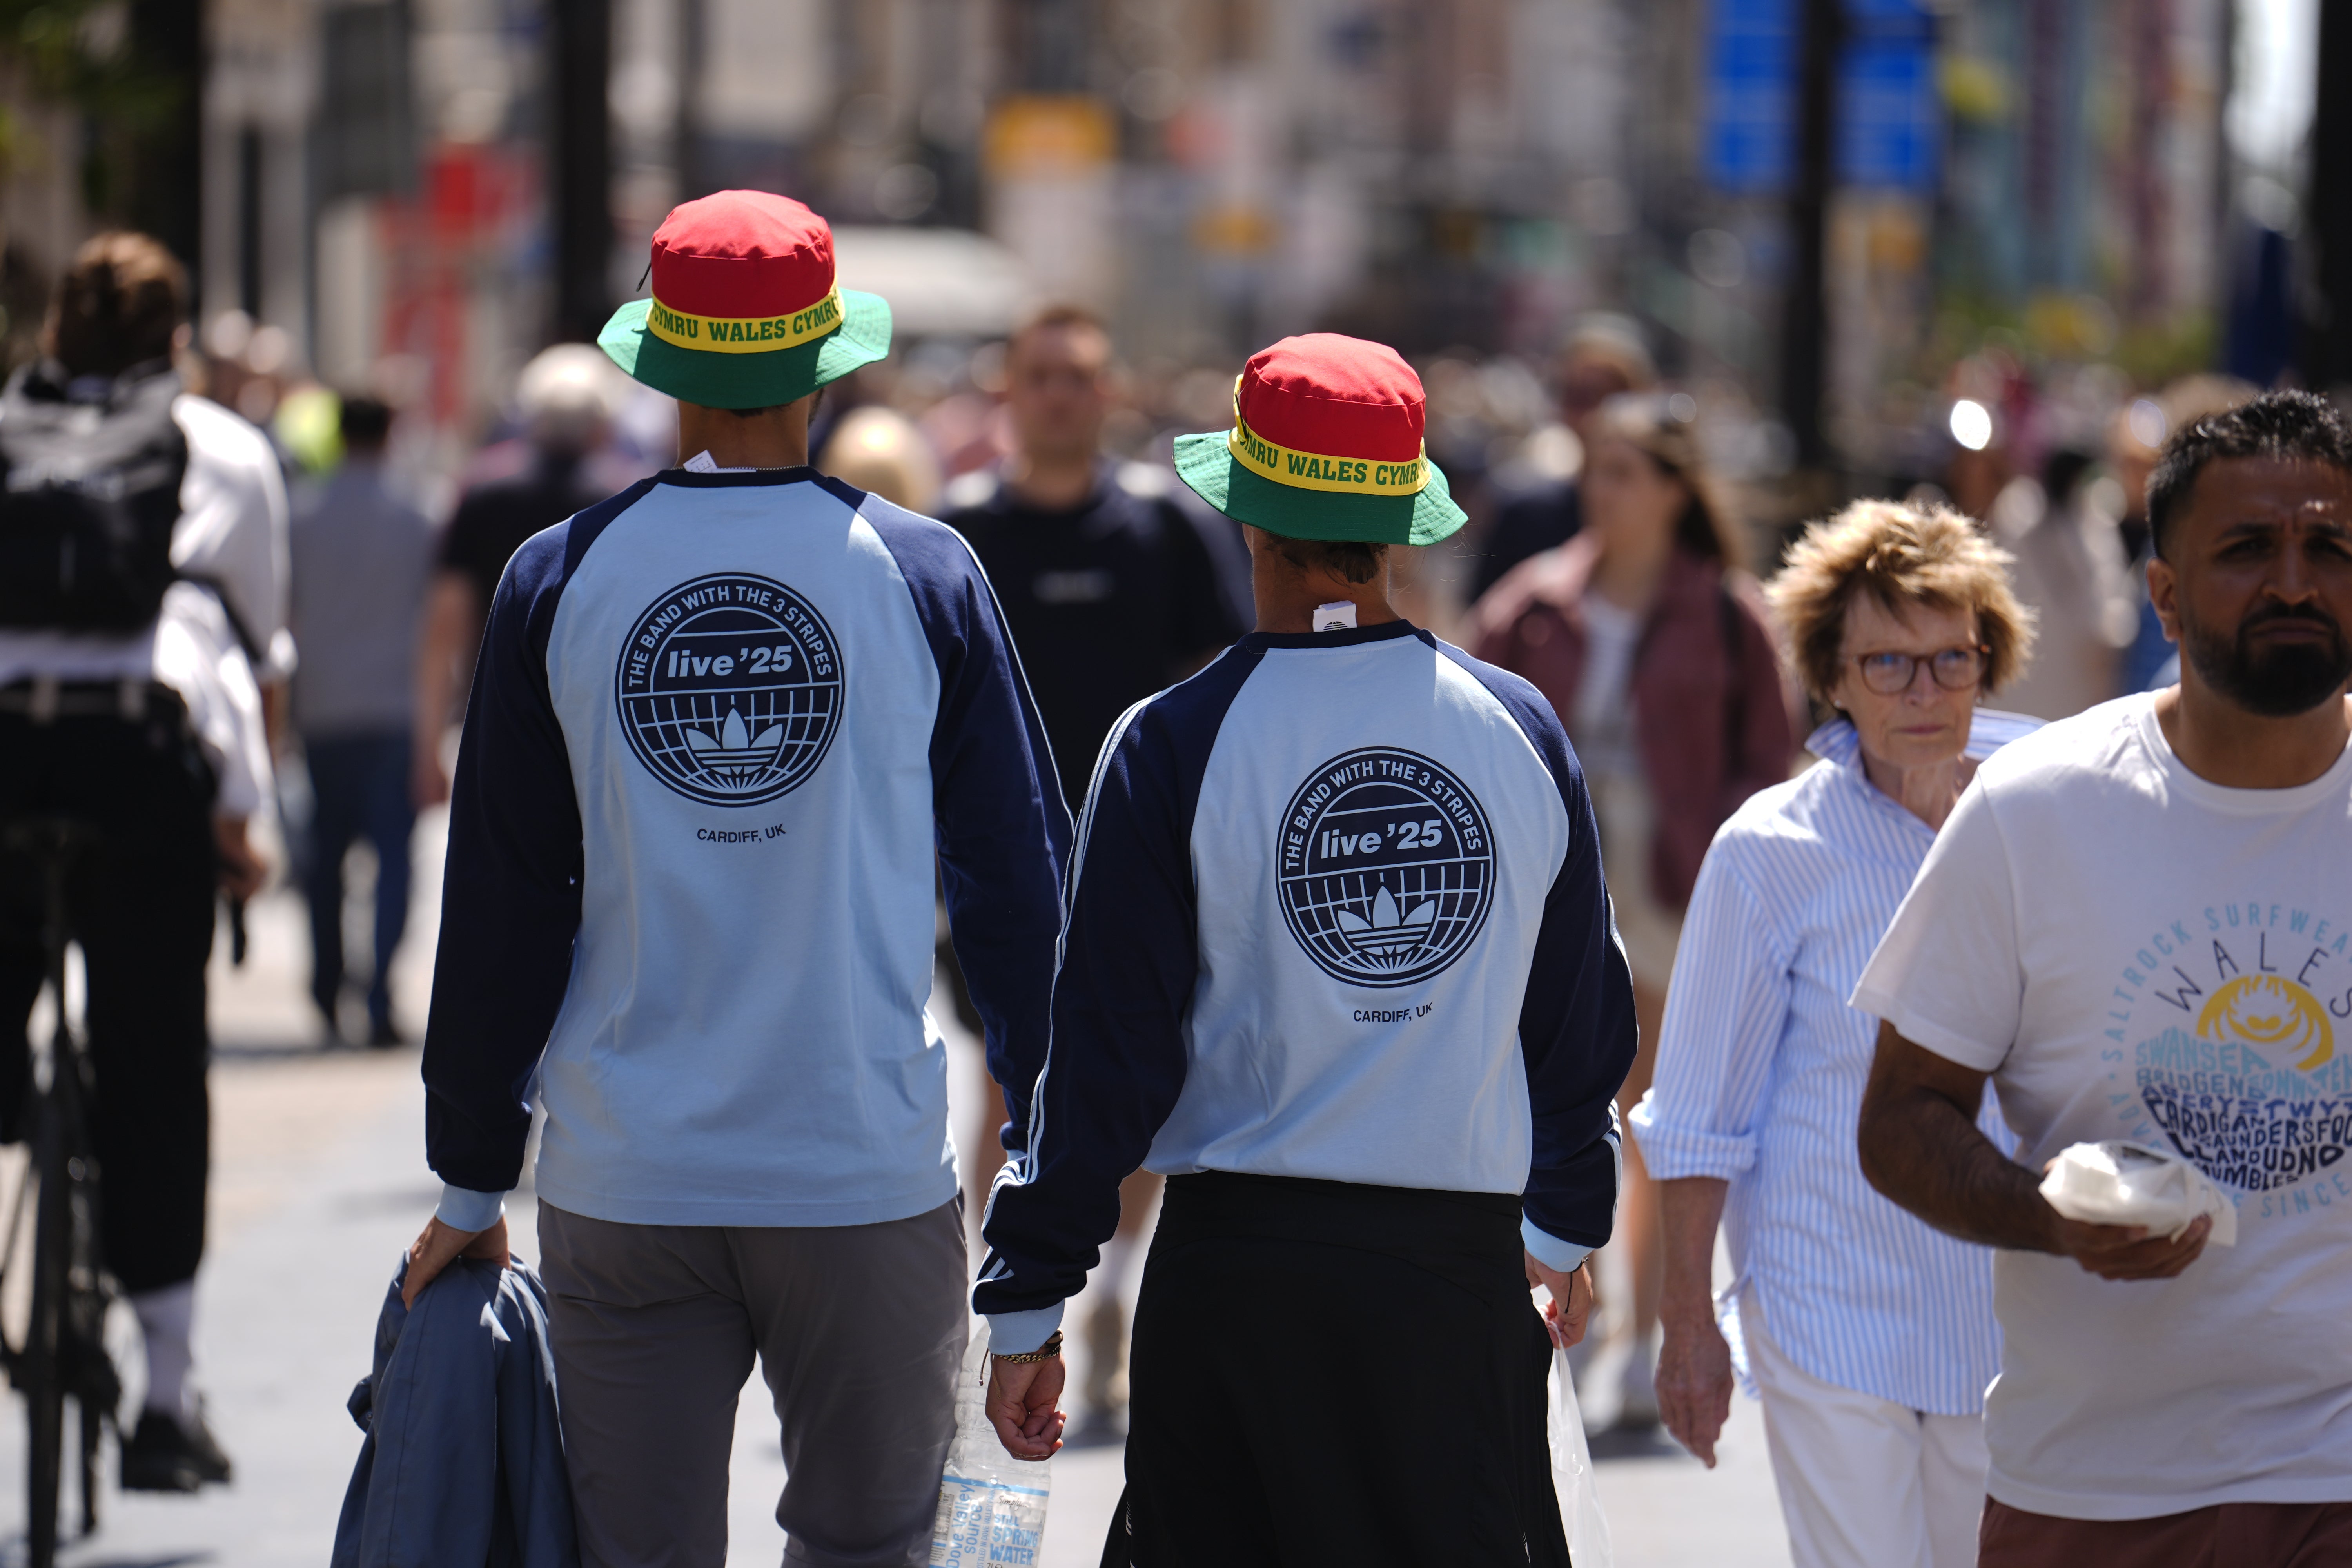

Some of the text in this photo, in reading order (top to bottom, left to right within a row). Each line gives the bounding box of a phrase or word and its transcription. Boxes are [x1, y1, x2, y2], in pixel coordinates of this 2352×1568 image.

[708, 319, 785, 341] WALES
[1288, 454, 1367, 483] WALES
[1376, 461, 1420, 485] CYMR
[628, 586, 831, 687] THE BAND WITH THE 3 STRIPES
[668, 645, 792, 677] live '25
[1285, 760, 1481, 870] THE BAND WITH THE 3 STRIPES
[697, 823, 787, 843] CARDIFF, UK
[1321, 819, 1442, 859] live '25
[2101, 902, 2352, 1062] SALTROCK SURFWEA
[1354, 1002, 1432, 1023] CARDIFF, UK
[2135, 1025, 2271, 1075] SWANSEA
[2167, 1131, 2344, 1176] LLANDUDNO
[2261, 1172, 2350, 1217] SINCE
[951, 1484, 975, 1527] Valley
[984, 1504, 993, 1525] VALLEY
[995, 1514, 1019, 1526] STILL
[981, 1525, 989, 1540] DOVE
[992, 1526, 1038, 1548] SPRING
[946, 1533, 964, 1568] Dove
[989, 1543, 1034, 1565] WATER
